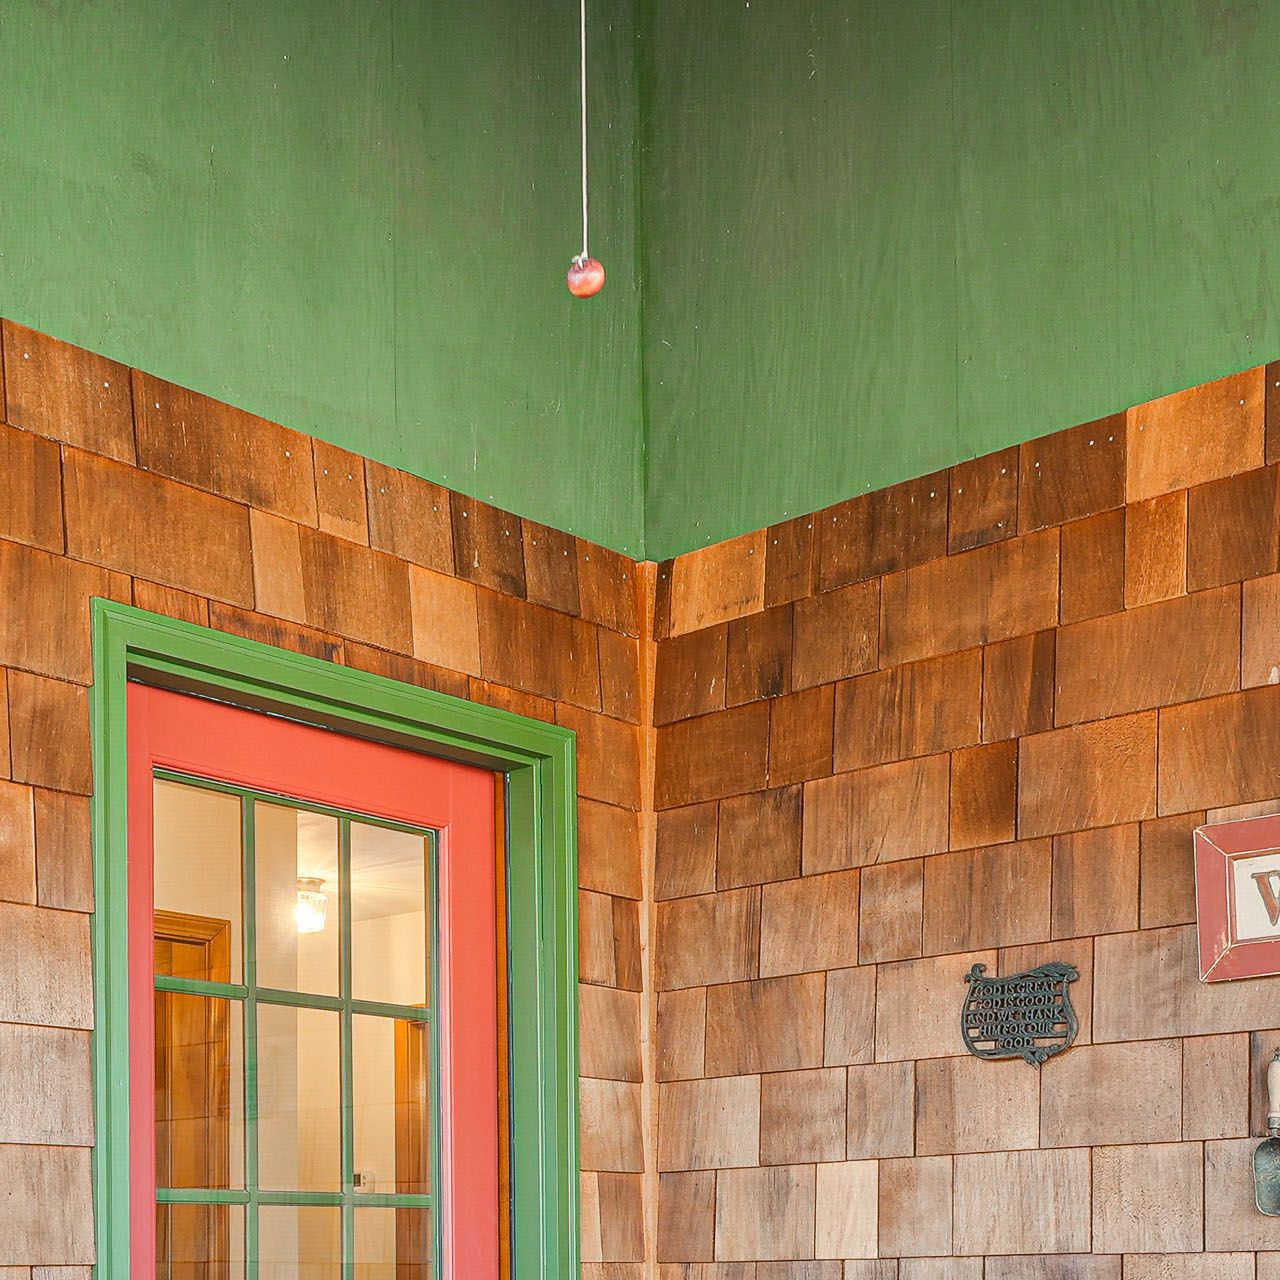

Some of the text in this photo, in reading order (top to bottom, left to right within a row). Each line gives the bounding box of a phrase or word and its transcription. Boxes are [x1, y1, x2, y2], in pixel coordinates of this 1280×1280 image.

[975, 981, 1055, 997] GOD IS GREAT
[975, 995, 1054, 1010] GOD IS GOOD
[967, 1006, 1063, 1025] AND WE THANK
[980, 1021, 1054, 1036] HIM FOR OUR
